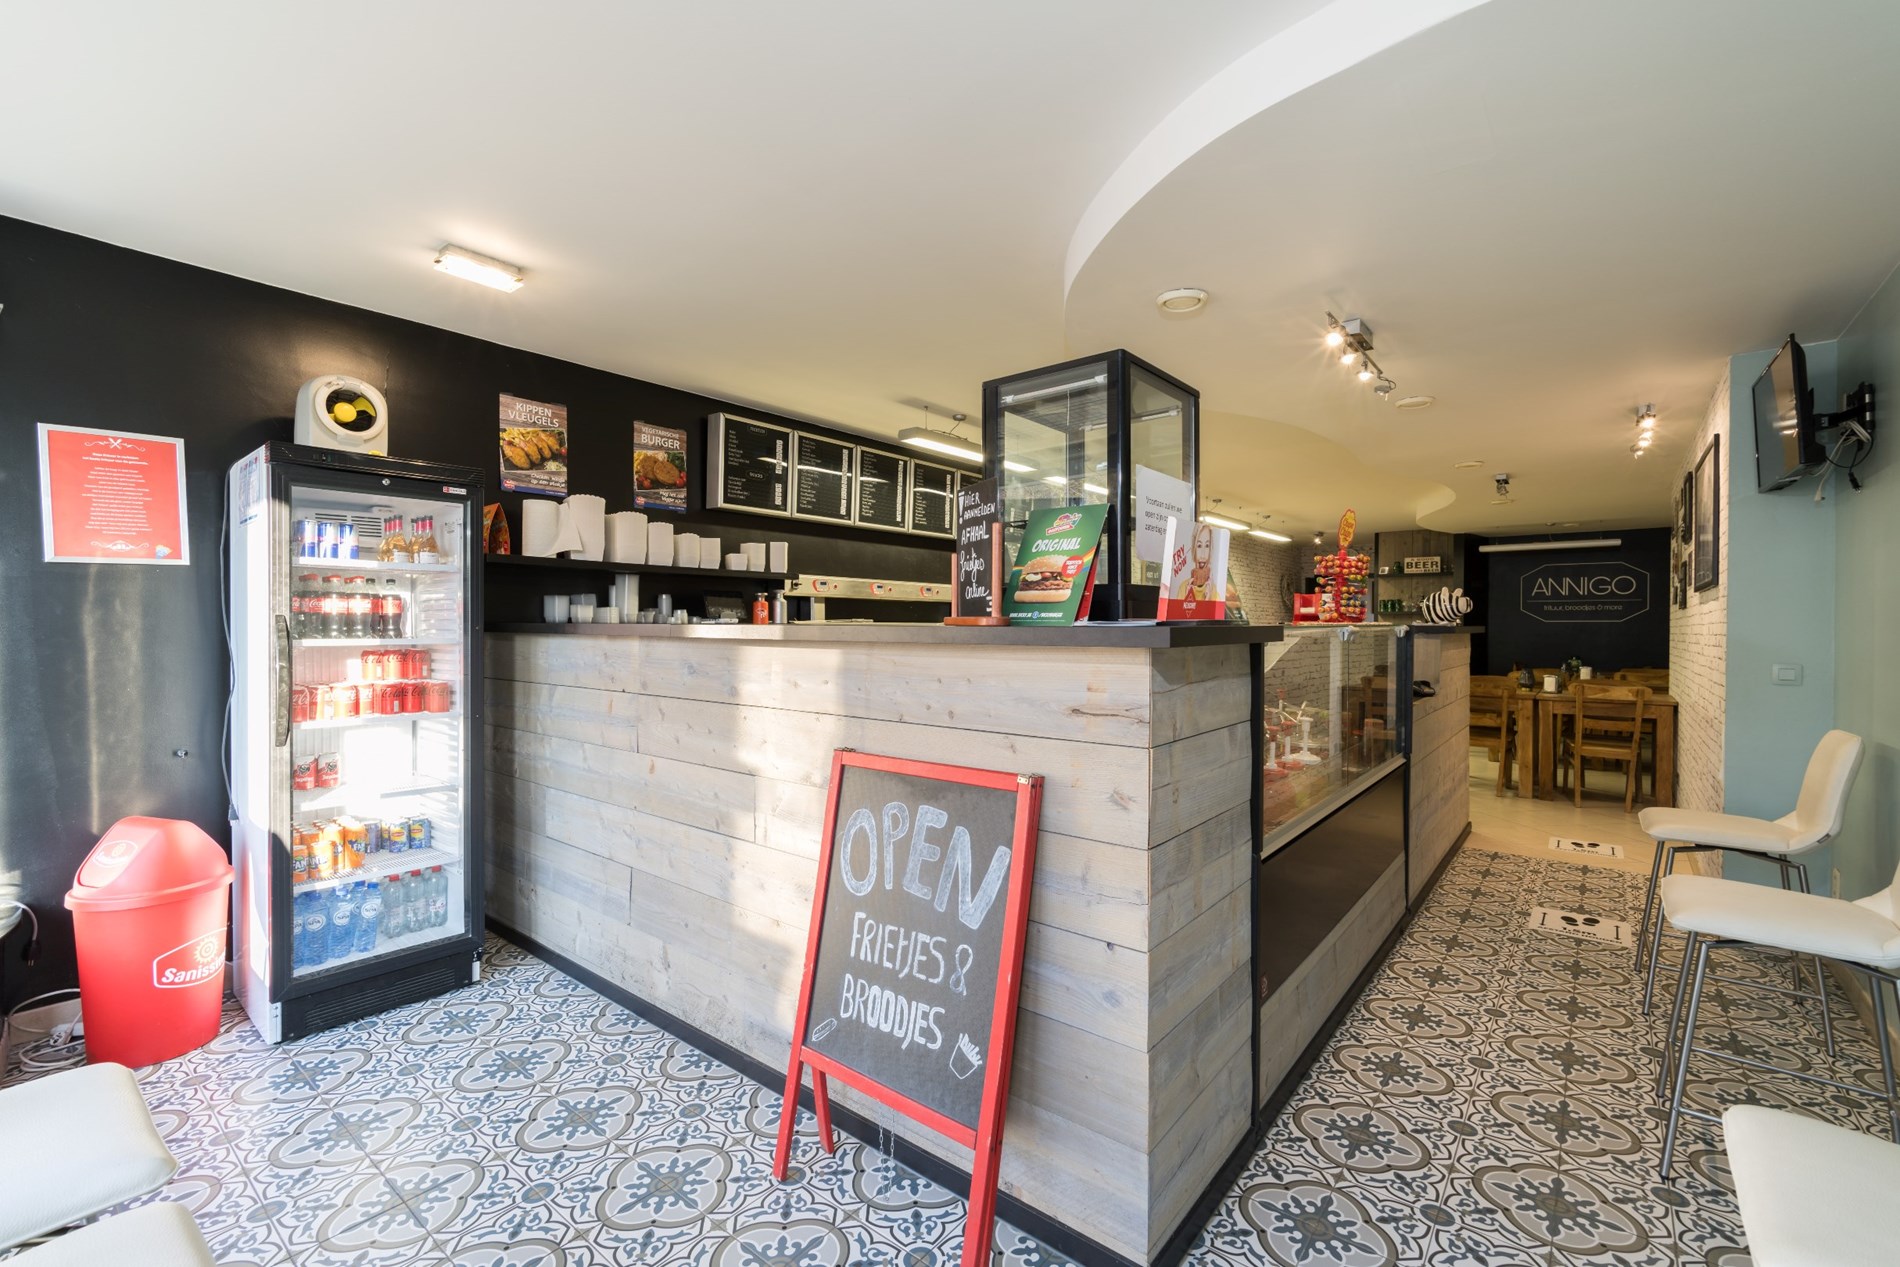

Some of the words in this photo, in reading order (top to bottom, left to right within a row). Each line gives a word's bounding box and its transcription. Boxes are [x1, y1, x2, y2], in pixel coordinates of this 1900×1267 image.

[508, 410, 559, 427] VLEUGELS
[516, 402, 552, 417] KIPPEN
[641, 426, 680, 440] VEGETARISCHE
[641, 433, 680, 450] BURGER
[961, 520, 990, 546] AFHAAL
[1031, 537, 1082, 553] ORIGINAL
[1172, 544, 1186, 565] TRY
[960, 547, 985, 582] frietjes
[1173, 556, 1187, 578] NOW
[1406, 560, 1439, 569] BEER
[1531, 575, 1637, 597] ANNIGO
[1564, 604, 1596, 612] broodjes
[840, 801, 1012, 930] OPEN
[849, 911, 948, 984] FRIETJES
[949, 943, 975, 997] &
[839, 973, 947, 1051] BROODJES
